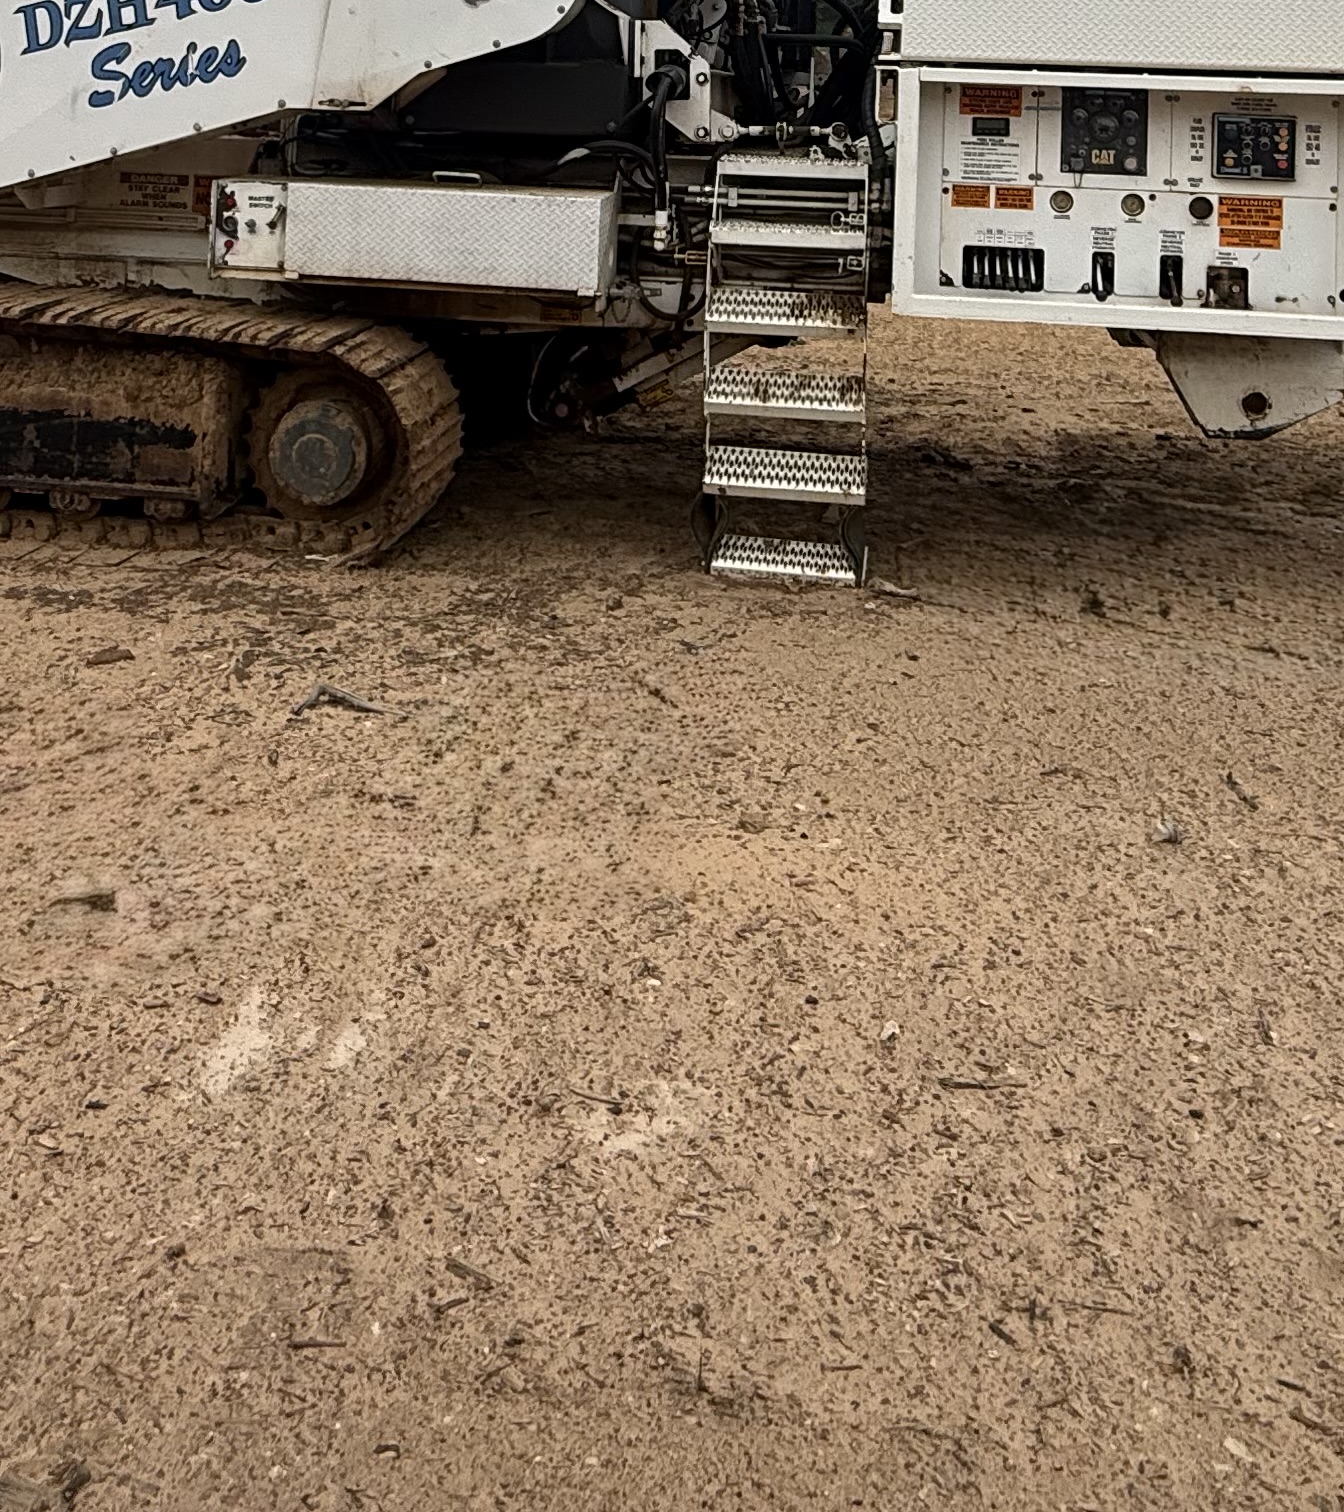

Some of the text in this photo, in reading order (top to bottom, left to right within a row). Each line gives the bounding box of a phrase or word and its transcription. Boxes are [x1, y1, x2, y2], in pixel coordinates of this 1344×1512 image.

[87, 38, 247, 108] Series
[964, 87, 1017, 98] WARNING
[1091, 149, 1116, 164] CAT
[130, 174, 179, 185] DANGER
[127, 184, 181, 194] STAY CLEAR
[141, 192, 168, 201] WHEN
[119, 199, 189, 210] ALARM SOUNDS
[1221, 198, 1280, 208] WARNING
